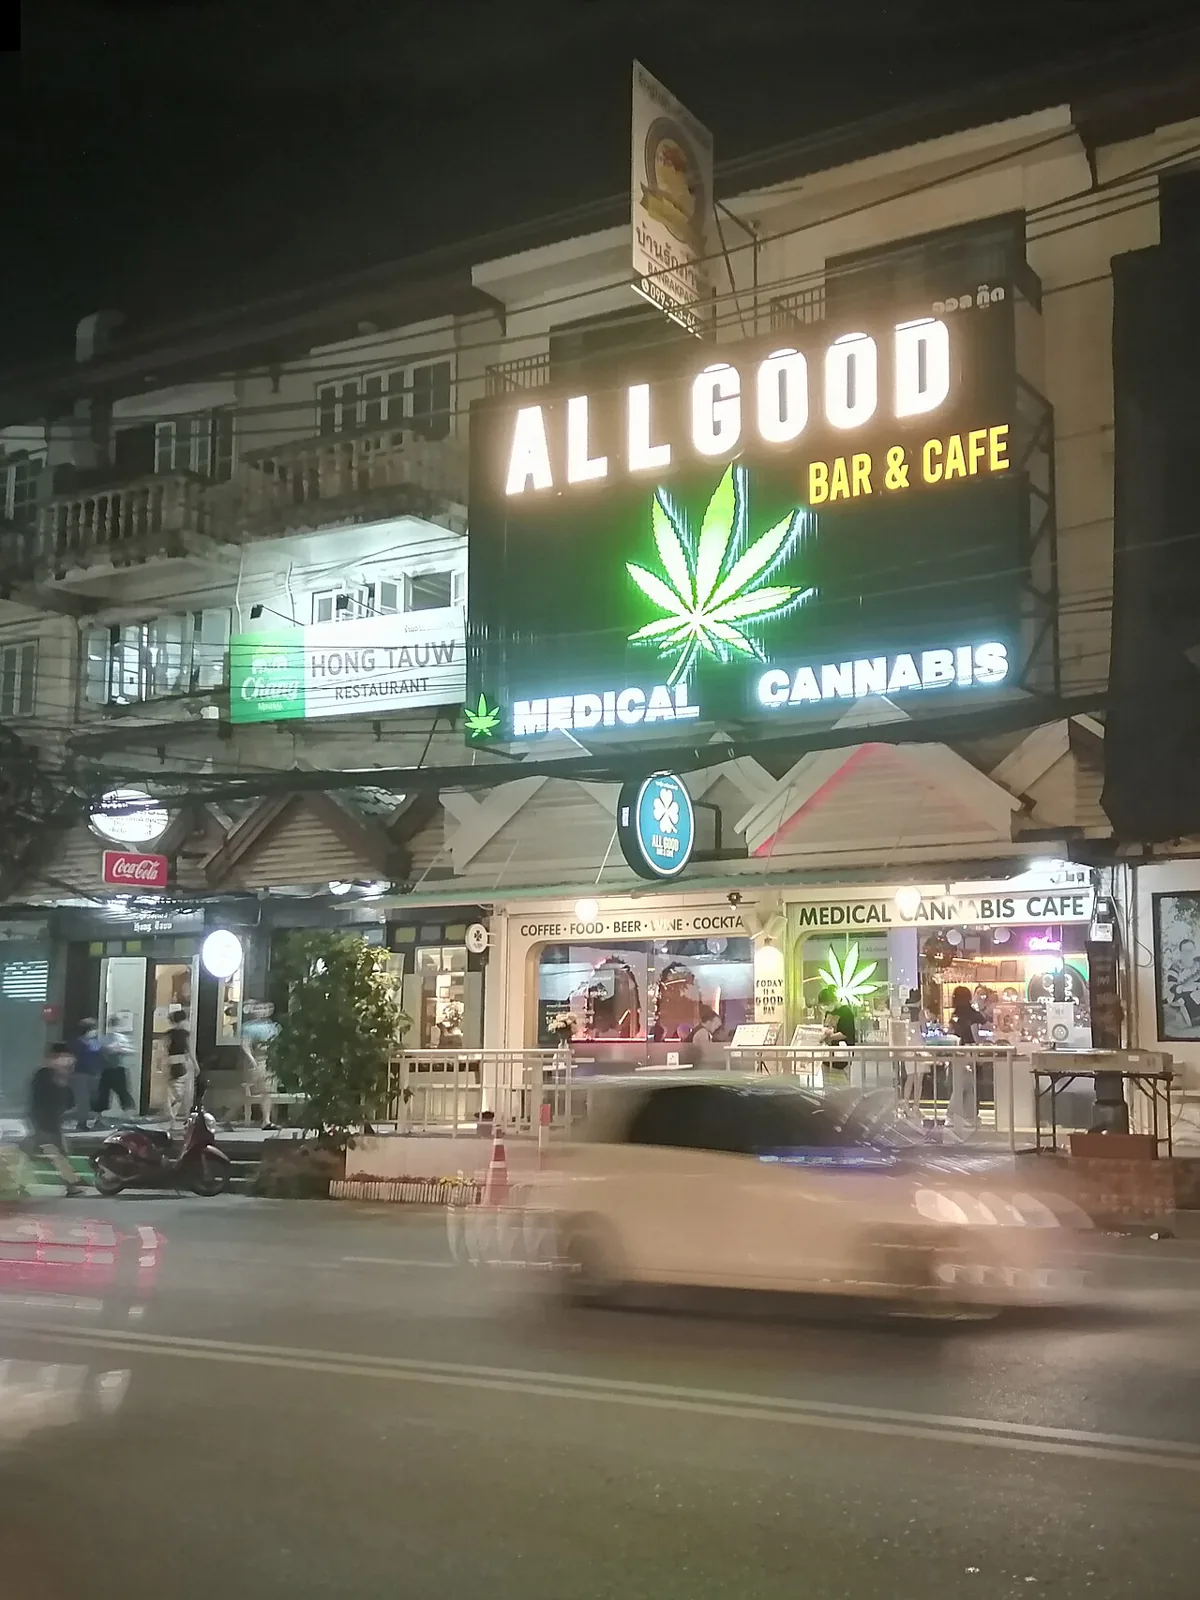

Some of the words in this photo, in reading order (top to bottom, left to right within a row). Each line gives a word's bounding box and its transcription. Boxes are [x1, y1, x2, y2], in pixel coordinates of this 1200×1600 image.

[506, 383, 672, 496] ALL
[692, 317, 951, 457] GOOD
[809, 452, 873, 505] BAR
[886, 445, 910, 491] &
[923, 425, 1010, 485] CAFE
[311, 649, 376, 678] HONG
[384, 638, 456, 669] TAUW
[335, 678, 430, 701] RESTAURANT
[757, 642, 1010, 708] CANNABIS
[513, 682, 700, 737] MEDICAL
[112, 857, 161, 880] Coca-Cola
[520, 923, 562, 937] COFFEE
[570, 921, 604, 935] FOOD
[613, 920, 642, 934] BEER
[693, 915, 744, 931] COCKTA
[799, 903, 892, 926] MEDICAL
[1026, 896, 1085, 917] CAFE
[756, 979, 784, 988] TODAY
[755, 996, 784, 1006] GOOD
